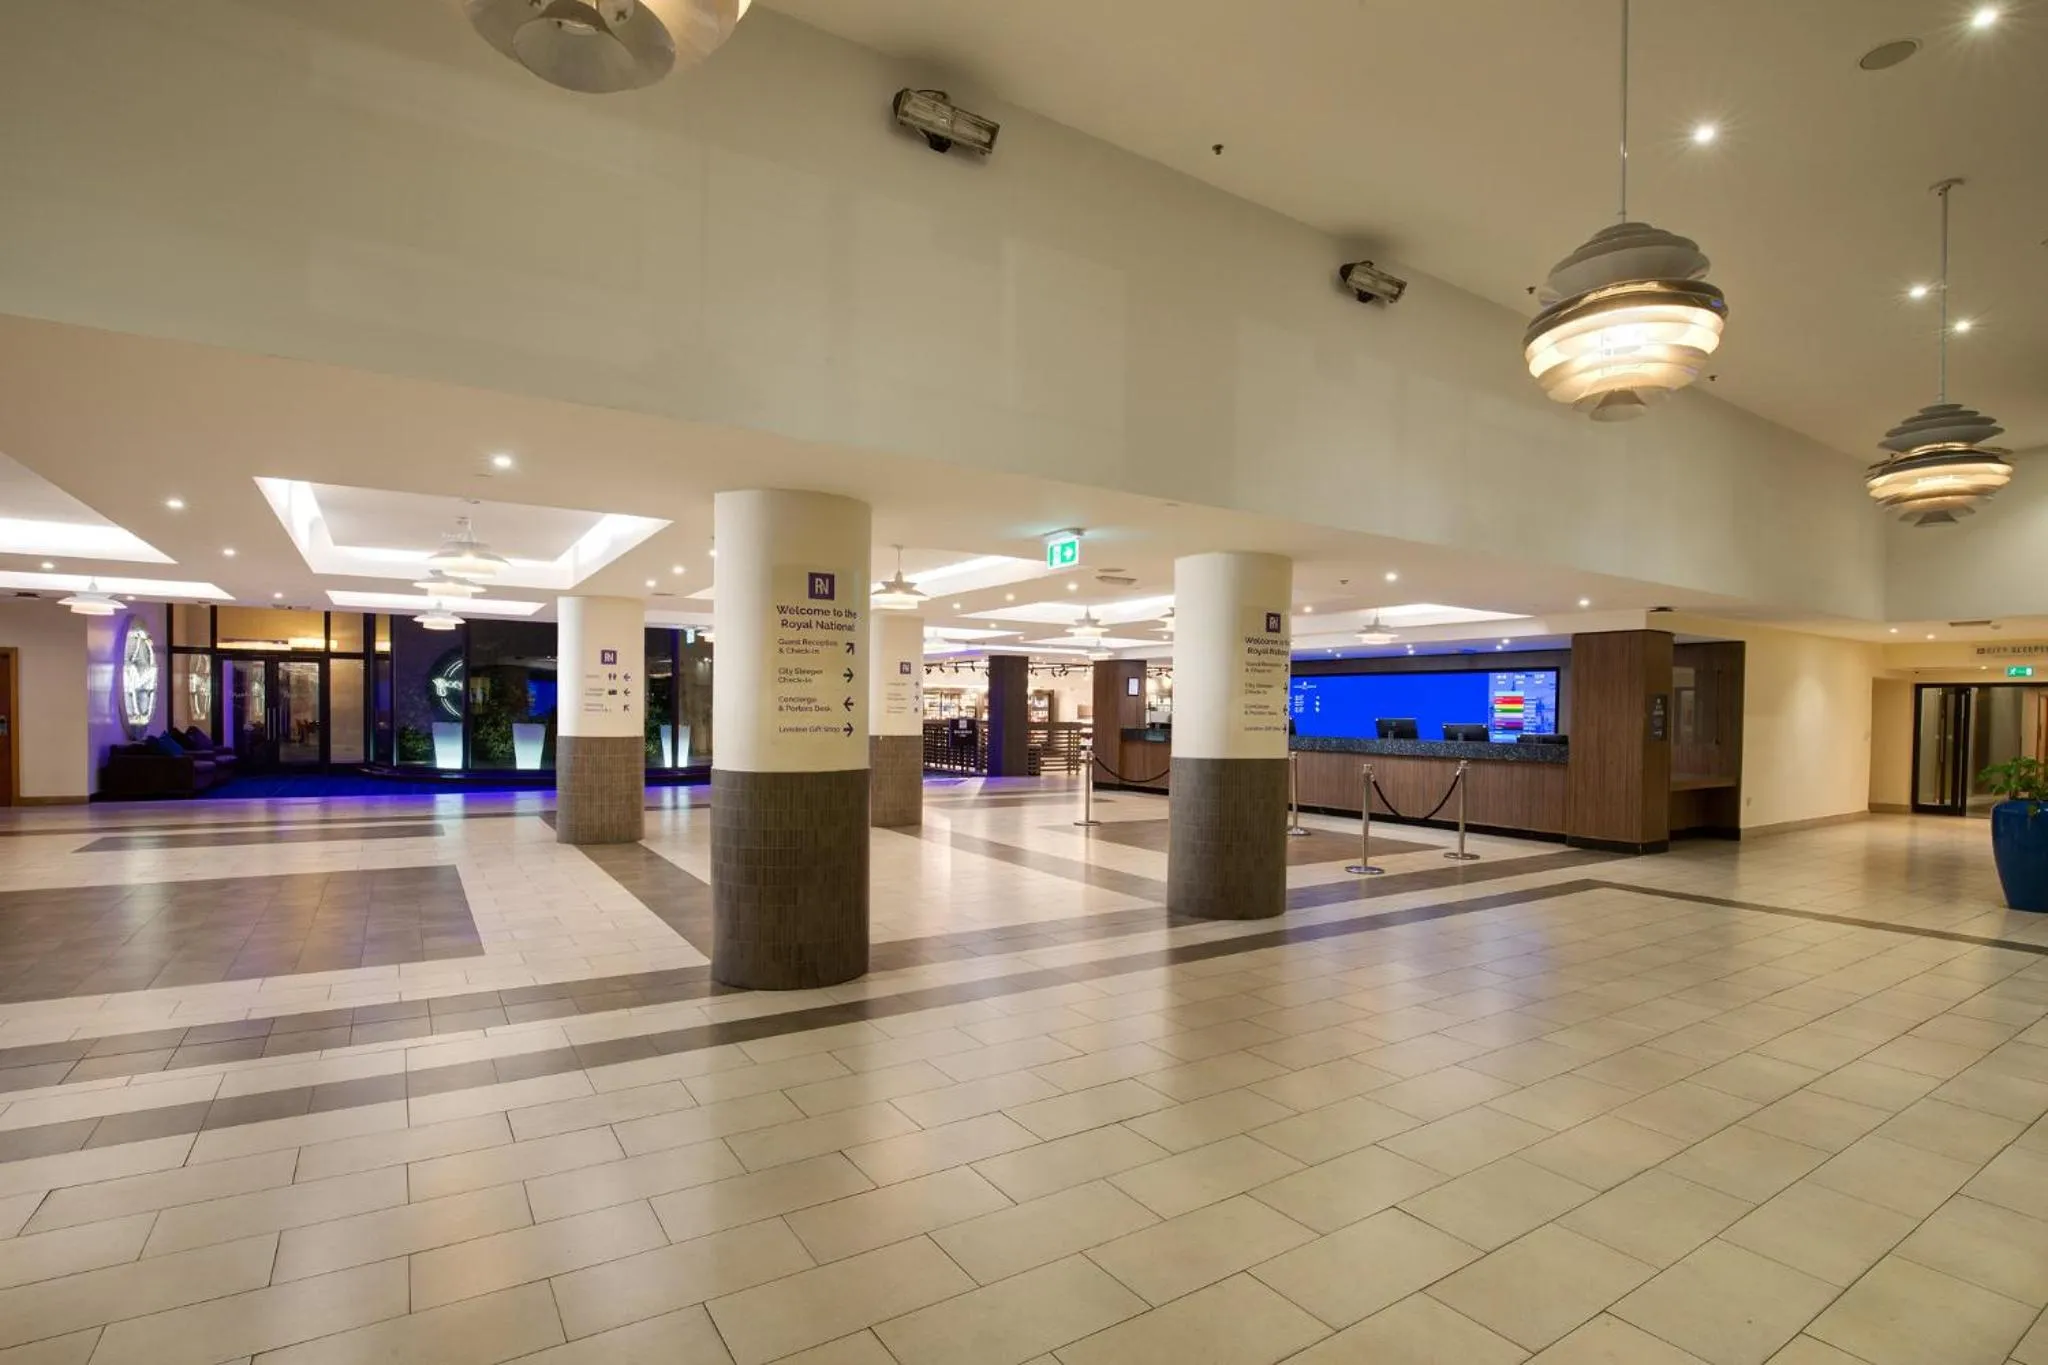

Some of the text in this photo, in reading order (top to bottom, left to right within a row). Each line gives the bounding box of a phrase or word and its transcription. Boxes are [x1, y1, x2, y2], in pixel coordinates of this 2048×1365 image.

[777, 605, 857, 620] Welcome to the
[781, 619, 855, 632] Royal National
[1245, 637, 1278, 646] Welcome
[778, 667, 823, 676] City Sleeper
